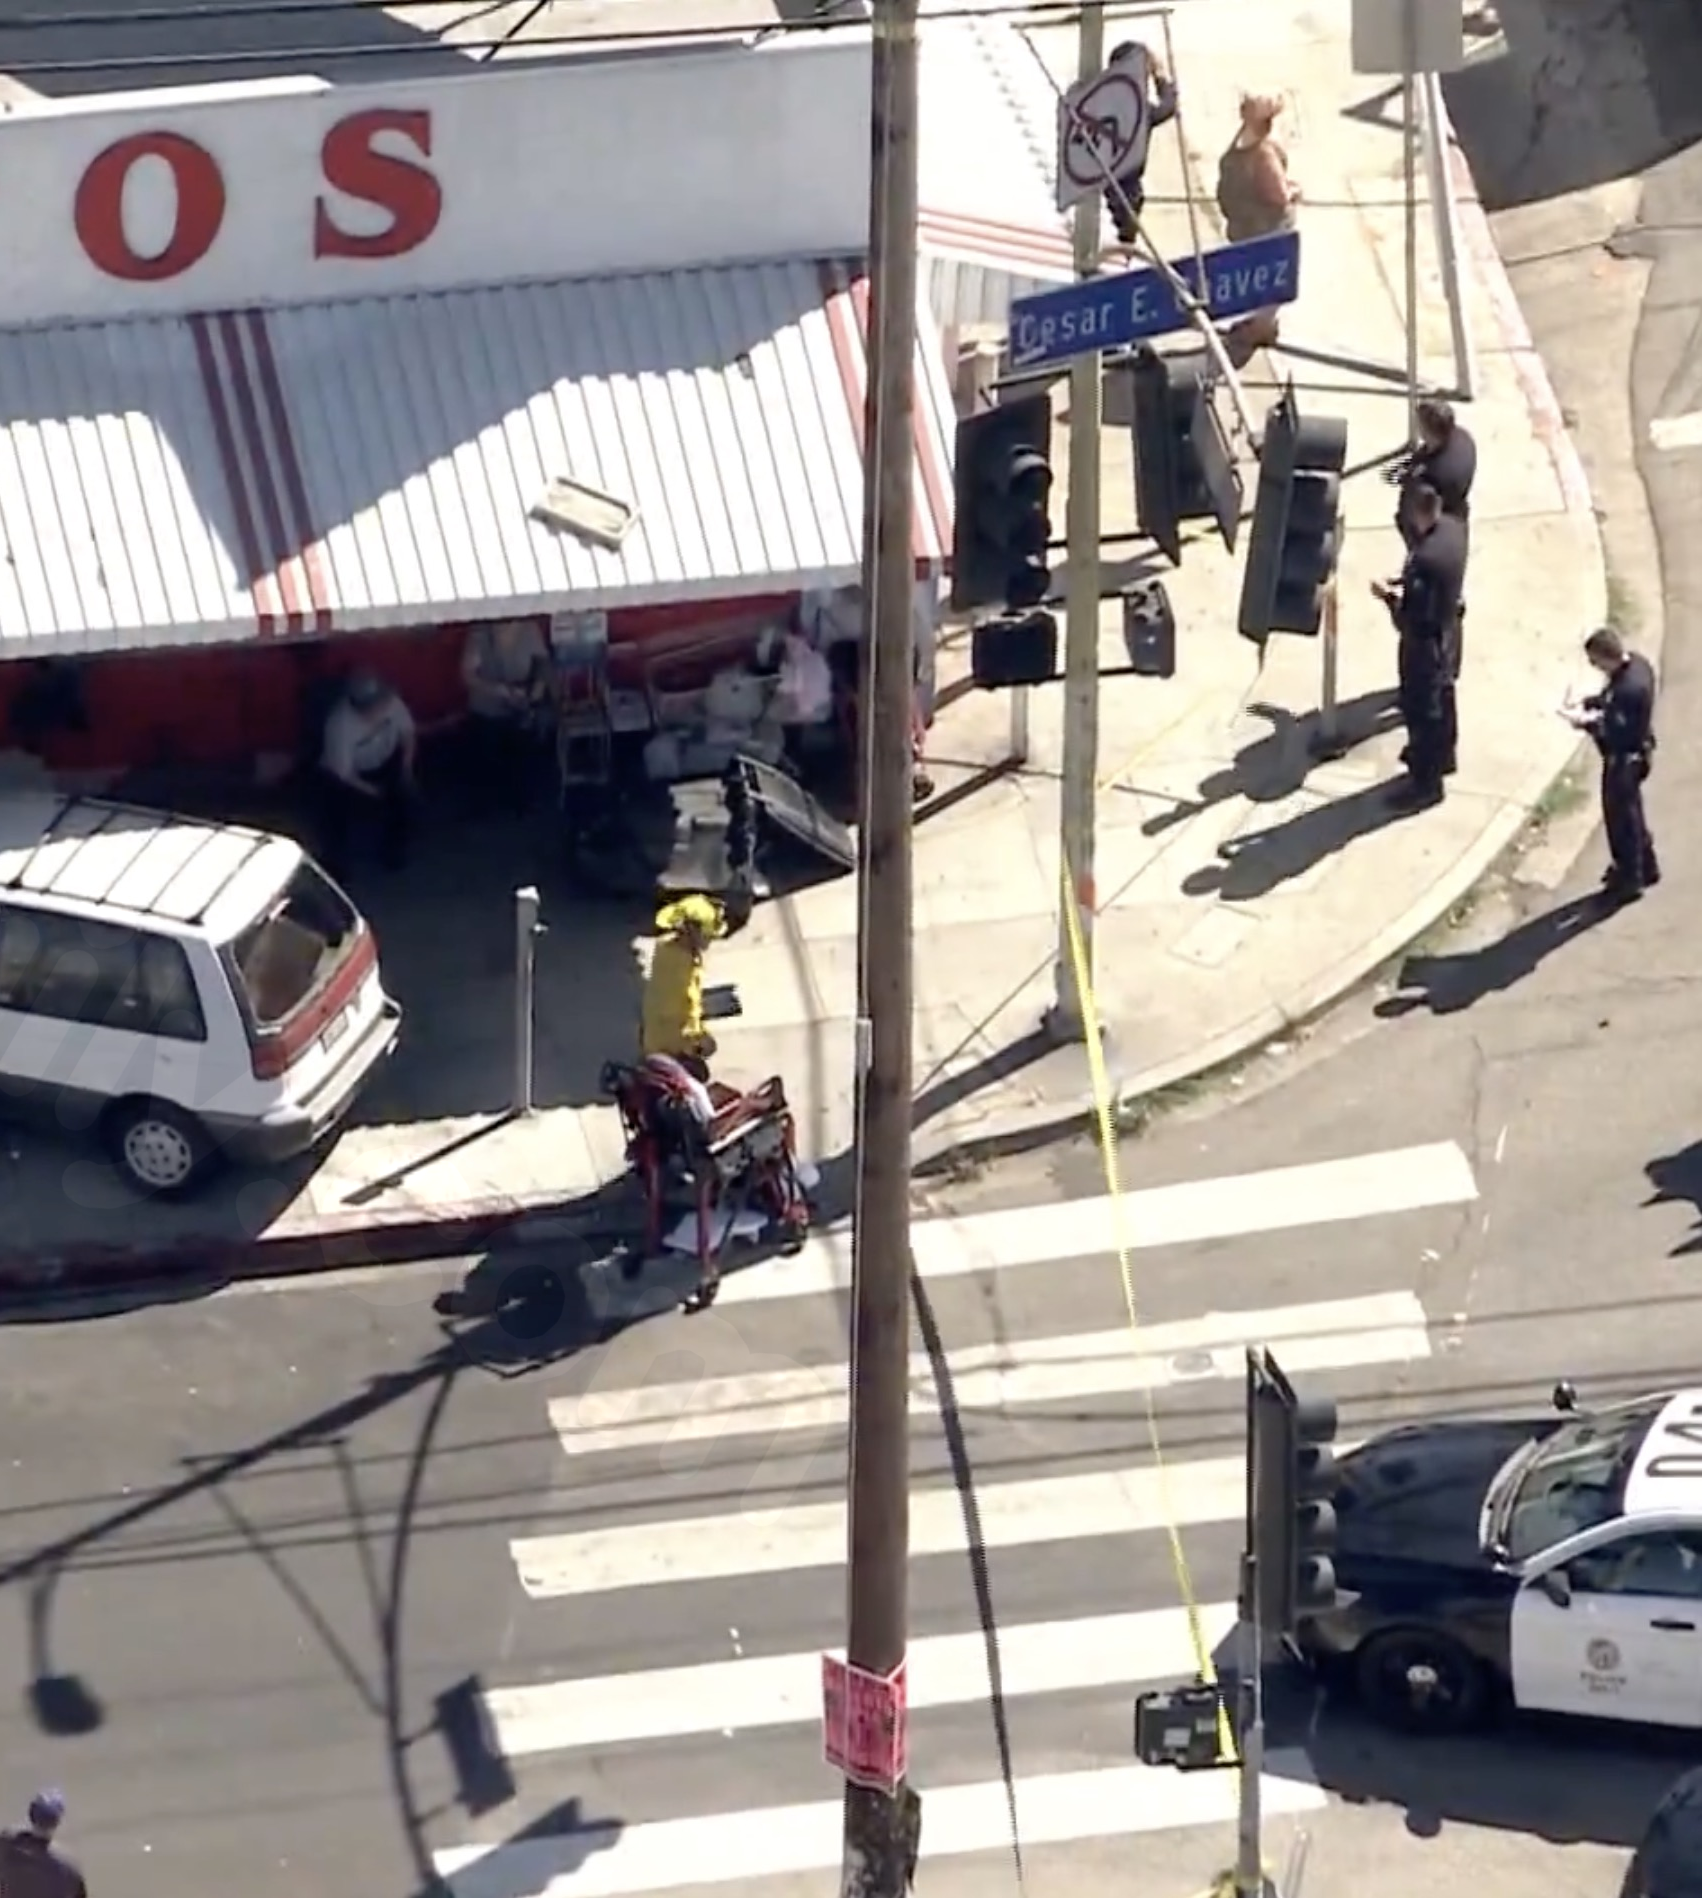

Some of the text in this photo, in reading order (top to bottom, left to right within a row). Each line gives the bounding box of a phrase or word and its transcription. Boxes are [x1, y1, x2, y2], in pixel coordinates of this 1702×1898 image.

[1018, 258, 1290, 350] Cesar E. avez
